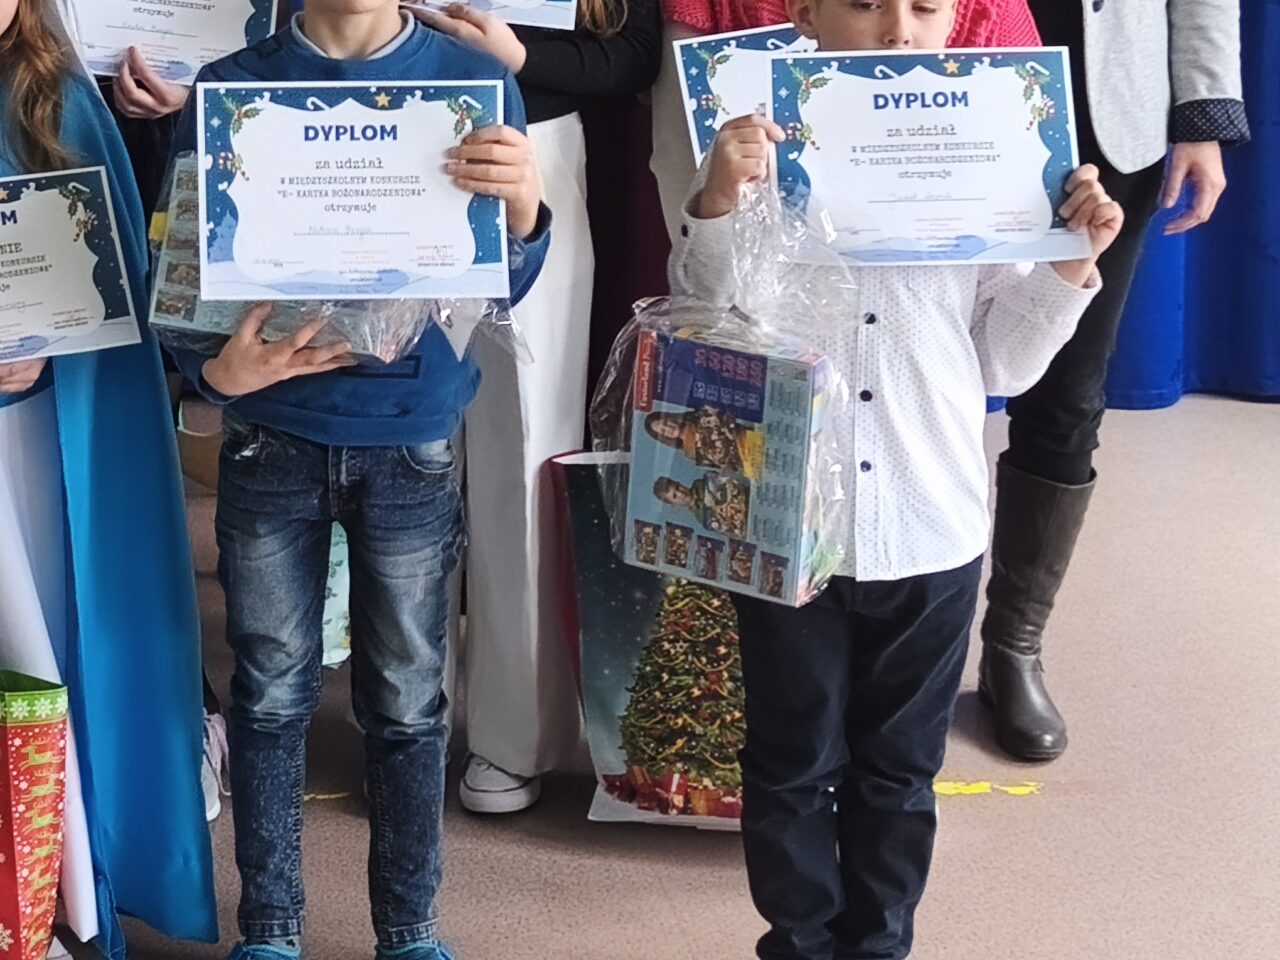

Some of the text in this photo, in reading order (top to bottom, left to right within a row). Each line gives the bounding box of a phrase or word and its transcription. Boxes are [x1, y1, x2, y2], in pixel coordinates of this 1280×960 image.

[873, 90, 970, 111] DYPLOM
[304, 124, 398, 141] DYPLOM
[887, 124, 957, 137] za udział
[315, 157, 384, 169] za udział
[370, 175, 421, 184] KONKURSIE
[297, 190, 329, 198] KARTKA
[324, 203, 377, 213] otrzymuje
